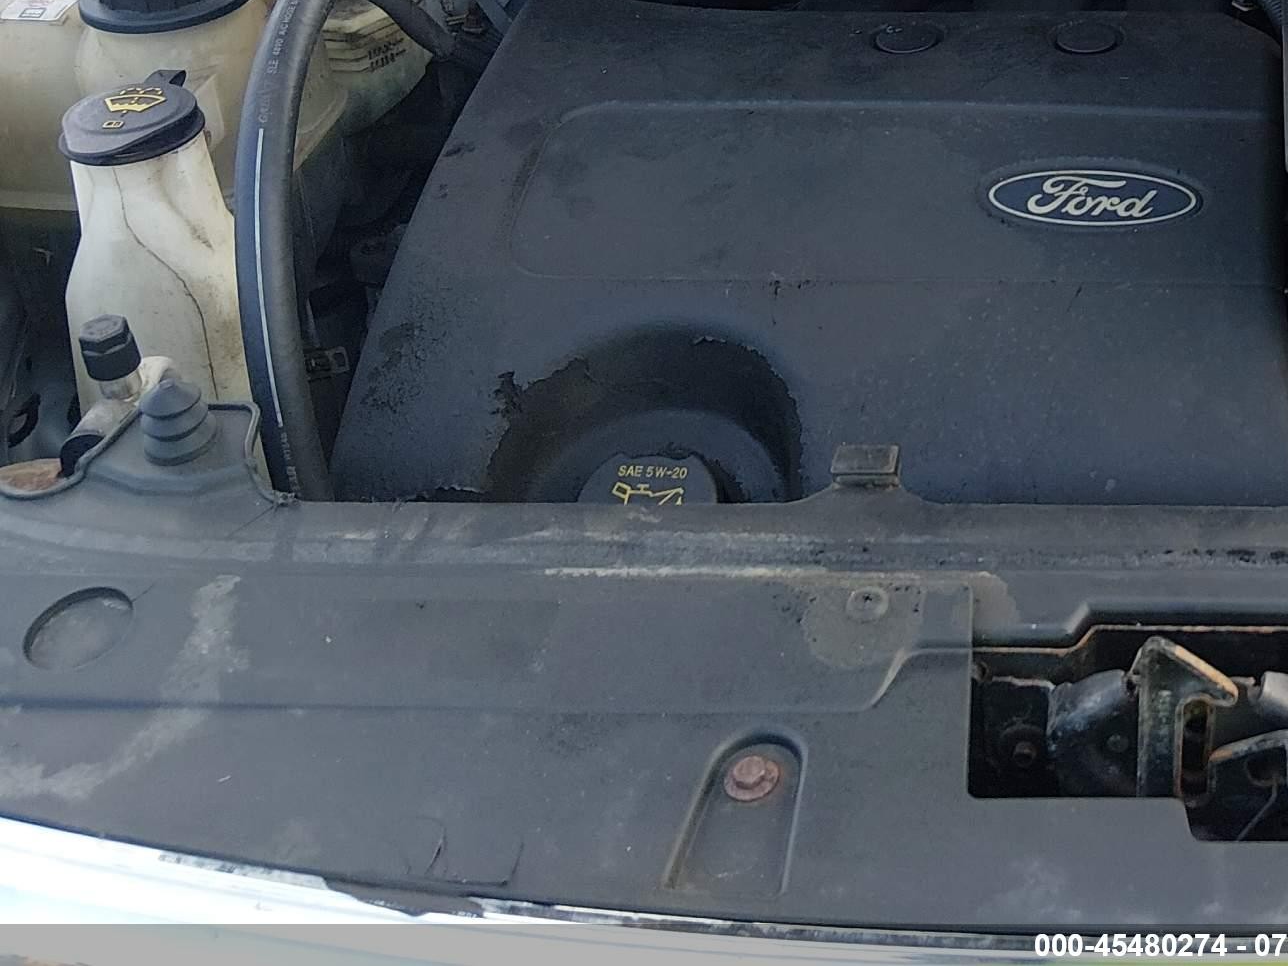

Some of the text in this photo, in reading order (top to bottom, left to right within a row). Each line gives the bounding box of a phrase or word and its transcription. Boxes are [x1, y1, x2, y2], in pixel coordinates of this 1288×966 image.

[1026, 175, 1158, 218] Ford
[618, 465, 688, 480] SAE 5W-20
